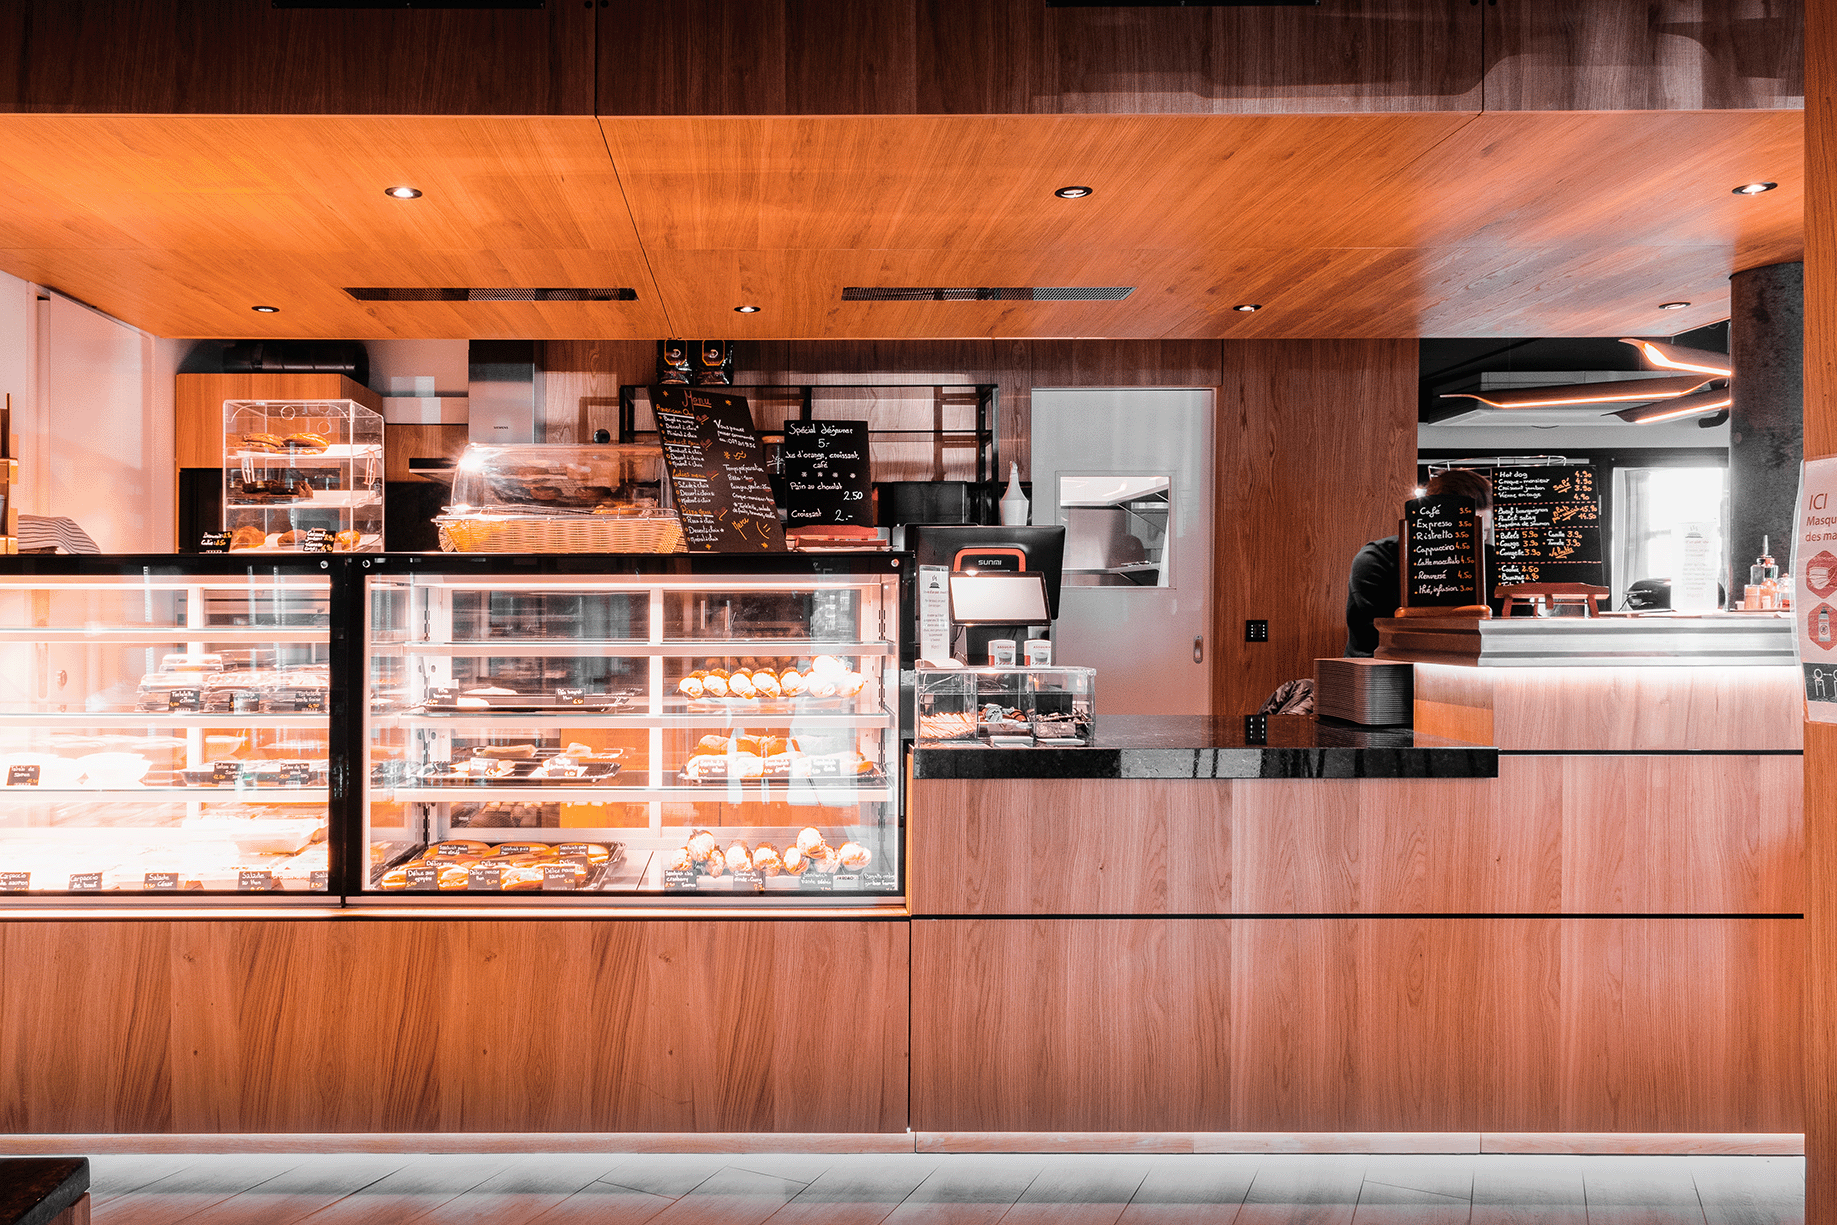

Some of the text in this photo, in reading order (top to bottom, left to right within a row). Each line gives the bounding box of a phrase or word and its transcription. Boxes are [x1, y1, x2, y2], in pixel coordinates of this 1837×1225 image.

[681, 389, 711, 411] Menu
[788, 423, 853, 437] Spécial déjeuner
[785, 450, 796, 459] Jus
[812, 460, 828, 469] café
[1513, 470, 1528, 479] dog
[789, 481, 806, 490] Pain
[816, 481, 843, 490] chocolat
[842, 490, 863, 501] 2.50
[1808, 493, 1828, 511] ICI
[1419, 504, 1472, 518] Café 3.50
[1416, 518, 1453, 531] Expresso
[1806, 515, 1837, 527] Masqu
[1416, 529, 1470, 541] Ristretto 3.50
[1522, 530, 1539, 538] 5.90
[1566, 530, 1583, 539] 3.90
[1805, 531, 1837, 542] des ma
[1455, 541, 1471, 550] 4.50
[1522, 540, 1539, 548] 3.90
[1565, 538, 1581, 547] 3.90
[1524, 548, 1541, 556] 3.90
[1460, 555, 1475, 564] 4.50
[1521, 565, 1539, 573] 2.50
[1457, 570, 1473, 579] 4.50
[1433, 583, 1459, 597] infusion
[70, 872, 99, 884] Carpaccio
[148, 873, 170, 881] Salade
